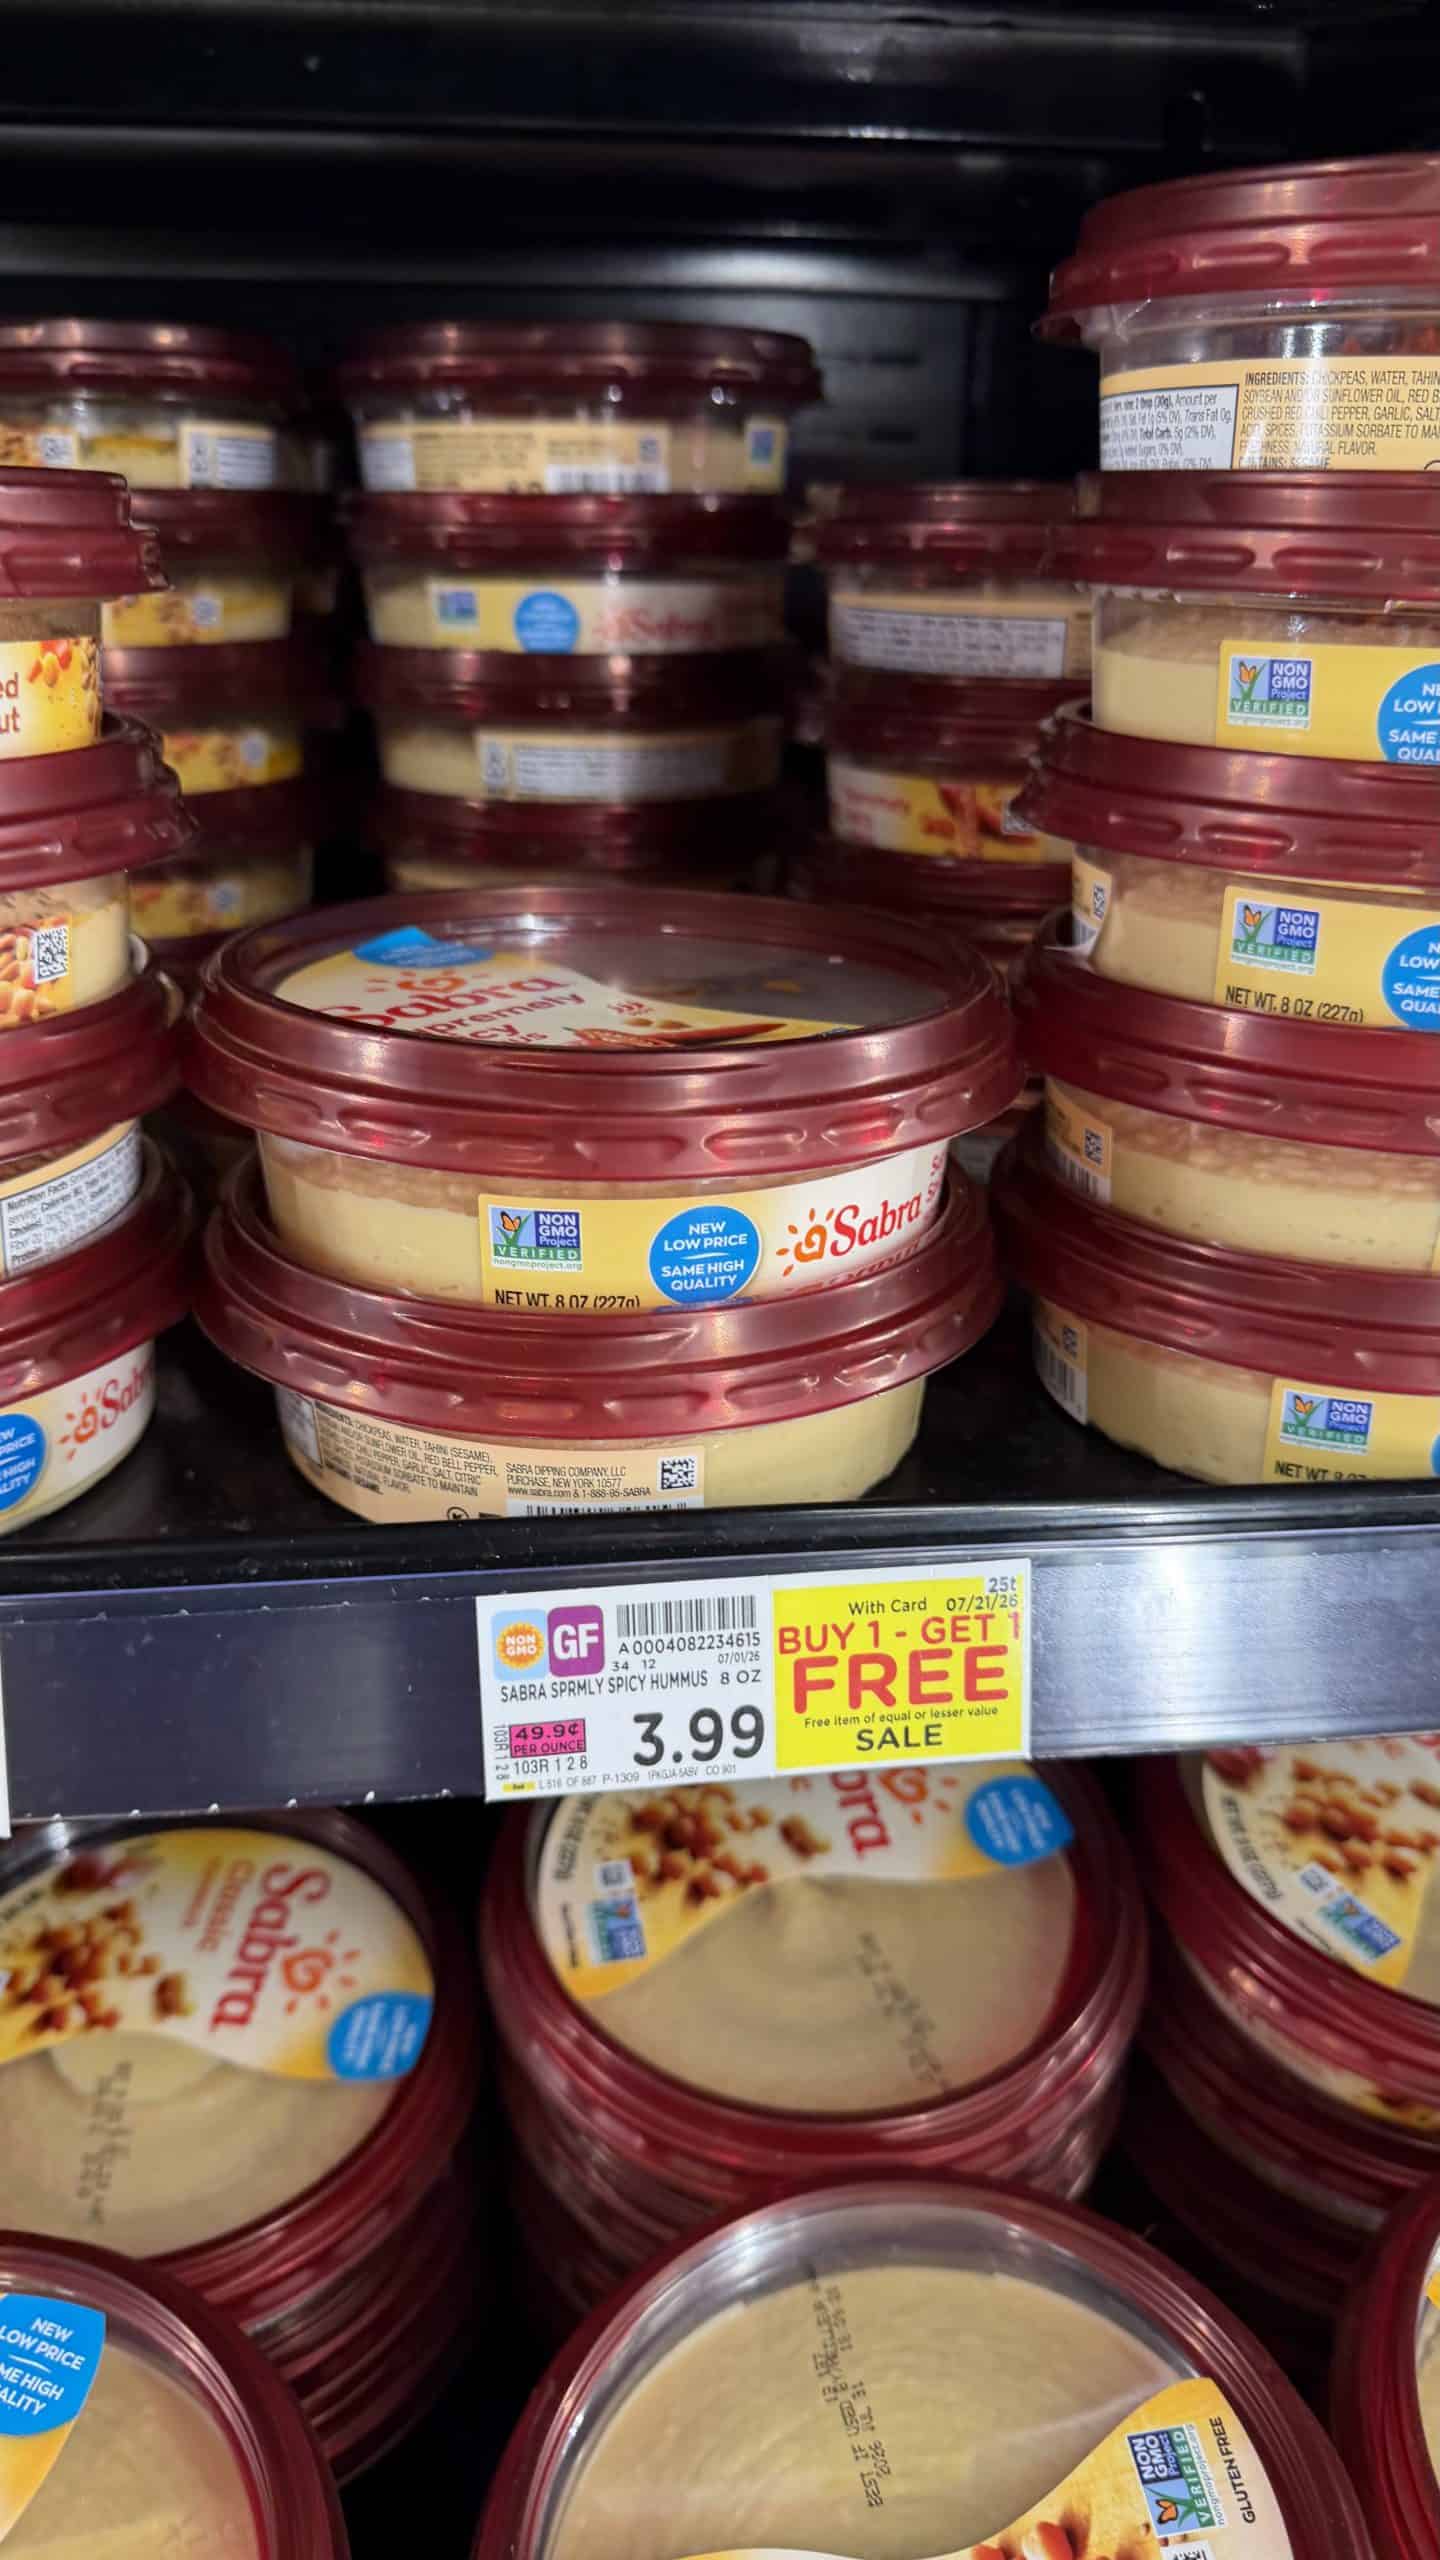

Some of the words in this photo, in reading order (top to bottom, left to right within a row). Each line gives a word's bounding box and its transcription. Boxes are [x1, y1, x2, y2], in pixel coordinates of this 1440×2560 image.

[1272, 663, 1308, 676] NON
[1271, 675, 1308, 689] GMO
[1231, 700, 1306, 716] VERIFIED
[1393, 699, 1436, 713] LOW
[1388, 729, 1438, 745] SAME
[1279, 911, 1315, 926] NON
[1278, 923, 1314, 939] GMO
[1225, 985, 1251, 1006] NET
[1254, 991, 1278, 1012] WT.
[1281, 997, 1290, 1014] 8
[1294, 998, 1314, 1017] OZ
[538, 1213, 576, 1226] NON
[688, 1220, 727, 1236] NEW
[830, 1191, 923, 1257] Sabra
[538, 1225, 577, 1238] GMO
[539, 1236, 577, 1248] Project
[663, 1238, 701, 1252] LOW
[703, 1233, 748, 1249] PRICE
[498, 1246, 578, 1260] VERIFIED
[661, 1263, 705, 1278] SAME
[707, 1259, 744, 1275] HIGH
[671, 1275, 738, 1292] QUALITY
[495, 1289, 522, 1305] NET
[555, 1294, 565, 1308] 8
[1329, 1410, 1368, 1425] GMO
[1331, 1401, 1368, 1415] NON
[505, 1462, 533, 1475] SABRA
[534, 1464, 567, 1477] DIPPING
[610, 1466, 626, 1477] LLC
[1275, 1459, 1303, 1479] NET
[1305, 1466, 1329, 1481] WT
[552, 1478, 571, 1488] NEW
[572, 1478, 594, 1489] YORK
[597, 1478, 622, 1489] 10577
[848, 1599, 885, 1615] With
[890, 1597, 927, 1613] Card
[946, 1592, 1018, 1613] 07/21/26
[506, 1634, 536, 1647] NON
[553, 1623, 599, 1661] GF
[778, 1621, 855, 1654] BUY
[867, 1620, 880, 1648] 1
[921, 1613, 995, 1644] GET
[1008, 1611, 1020, 1640] 1
[506, 1644, 537, 1657] GMO
[718, 1651, 760, 1665] 07/01/26
[612, 1660, 629, 1672] 34
[642, 1658, 656, 1670] 12
[501, 1682, 547, 1703] SABRA
[551, 1678, 605, 1699] SPRMLY
[608, 1673, 646, 1693] SPICY
[650, 1669, 708, 1689] HUMMUS
[720, 1672, 730, 1685] 8
[736, 1669, 761, 1684] OZ
[793, 1645, 1009, 1714] FREE
[805, 1716, 830, 1729] Free
[834, 1714, 860, 1727] item
[864, 1711, 876, 1724] of
[879, 1710, 911, 1724] equal
[915, 1710, 927, 1721] or
[930, 1707, 964, 1719] lesser
[968, 1705, 998, 1717] value
[493, 1724, 509, 1751] 103R
[515, 1722, 579, 1741] 49.9¢
[633, 1704, 765, 1767] 3.99
[856, 1723, 943, 1752] SALE
[514, 1743, 537, 1755] PER
[541, 1740, 584, 1753] OUNCE
[514, 1758, 549, 1775] 103R
[555, 1756, 561, 1772] 1
[567, 1756, 575, 1771] 2
[579, 1755, 588, 1770] 8
[210, 1862, 333, 2034] Sabra
[30, 2316, 75, 2342] NEW
[0, 2325, 39, 2351] LOW
[34, 2341, 86, 2371] PRICE
[19, 2372, 65, 2401] HIGH
[0, 2384, 47, 2416] ALITY
[1209, 2416, 1234, 2457] FREE
[1132, 2438, 1157, 2480] NON
[1145, 2435, 1169, 2478] GMO
[1159, 2432, 1180, 2477] Project
[1173, 2431, 1208, 2523] VERIFIED
[1224, 2458, 1257, 2524] GLUTEN
